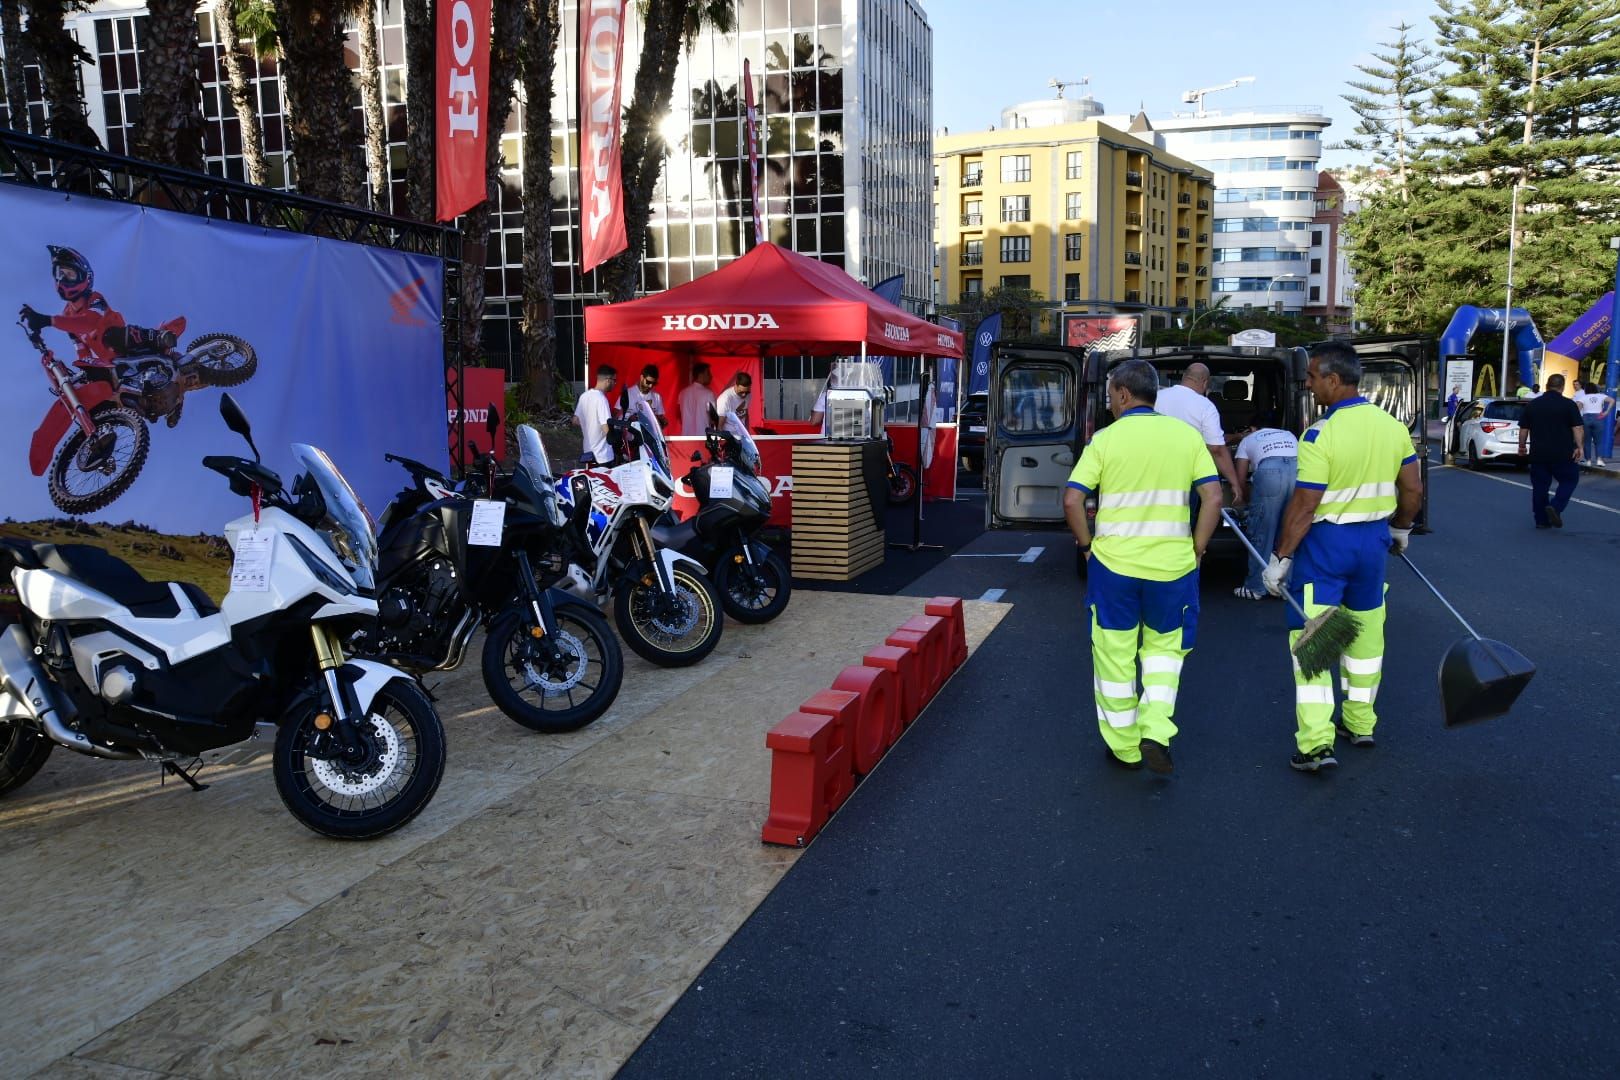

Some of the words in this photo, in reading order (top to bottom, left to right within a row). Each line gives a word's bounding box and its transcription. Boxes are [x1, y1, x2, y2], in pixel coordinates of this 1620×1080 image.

[662, 313, 779, 331] HONDA
[1582, 315, 1609, 338] centro
[884, 322, 910, 341] HONDA
[937, 333, 955, 349] HONDA
[447, 408, 489, 424] HOND
